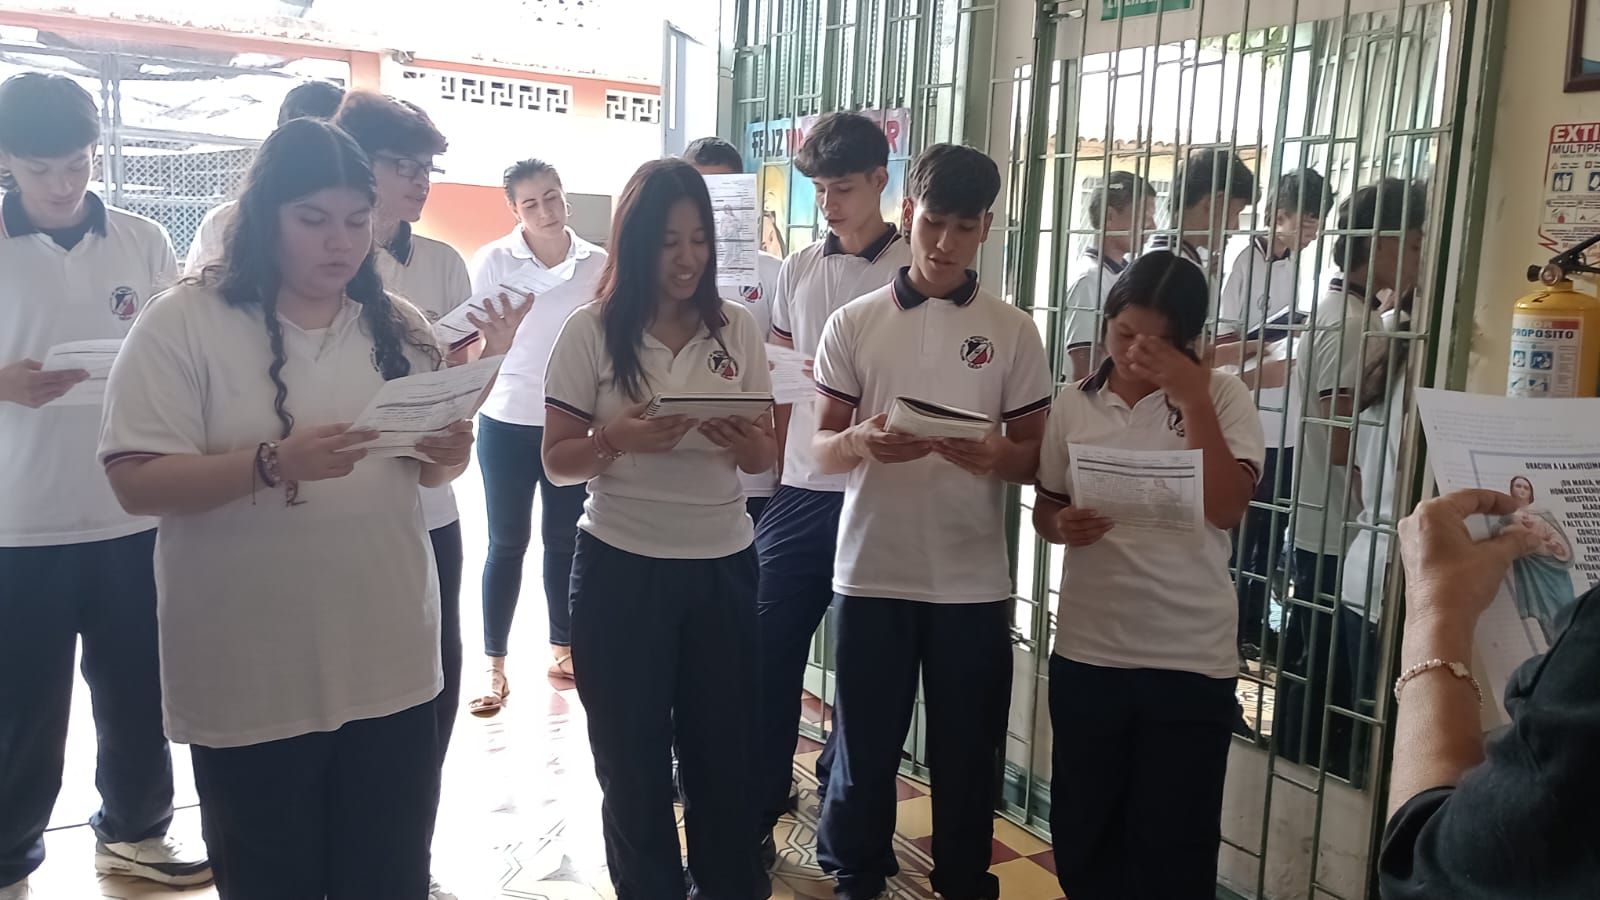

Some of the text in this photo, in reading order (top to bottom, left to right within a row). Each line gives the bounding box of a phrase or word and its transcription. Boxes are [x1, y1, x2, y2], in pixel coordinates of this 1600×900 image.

[1553, 125, 1599, 142] EXTI
[752, 128, 783, 158] FELIZ
[1512, 328, 1574, 339] PROPOSITO
